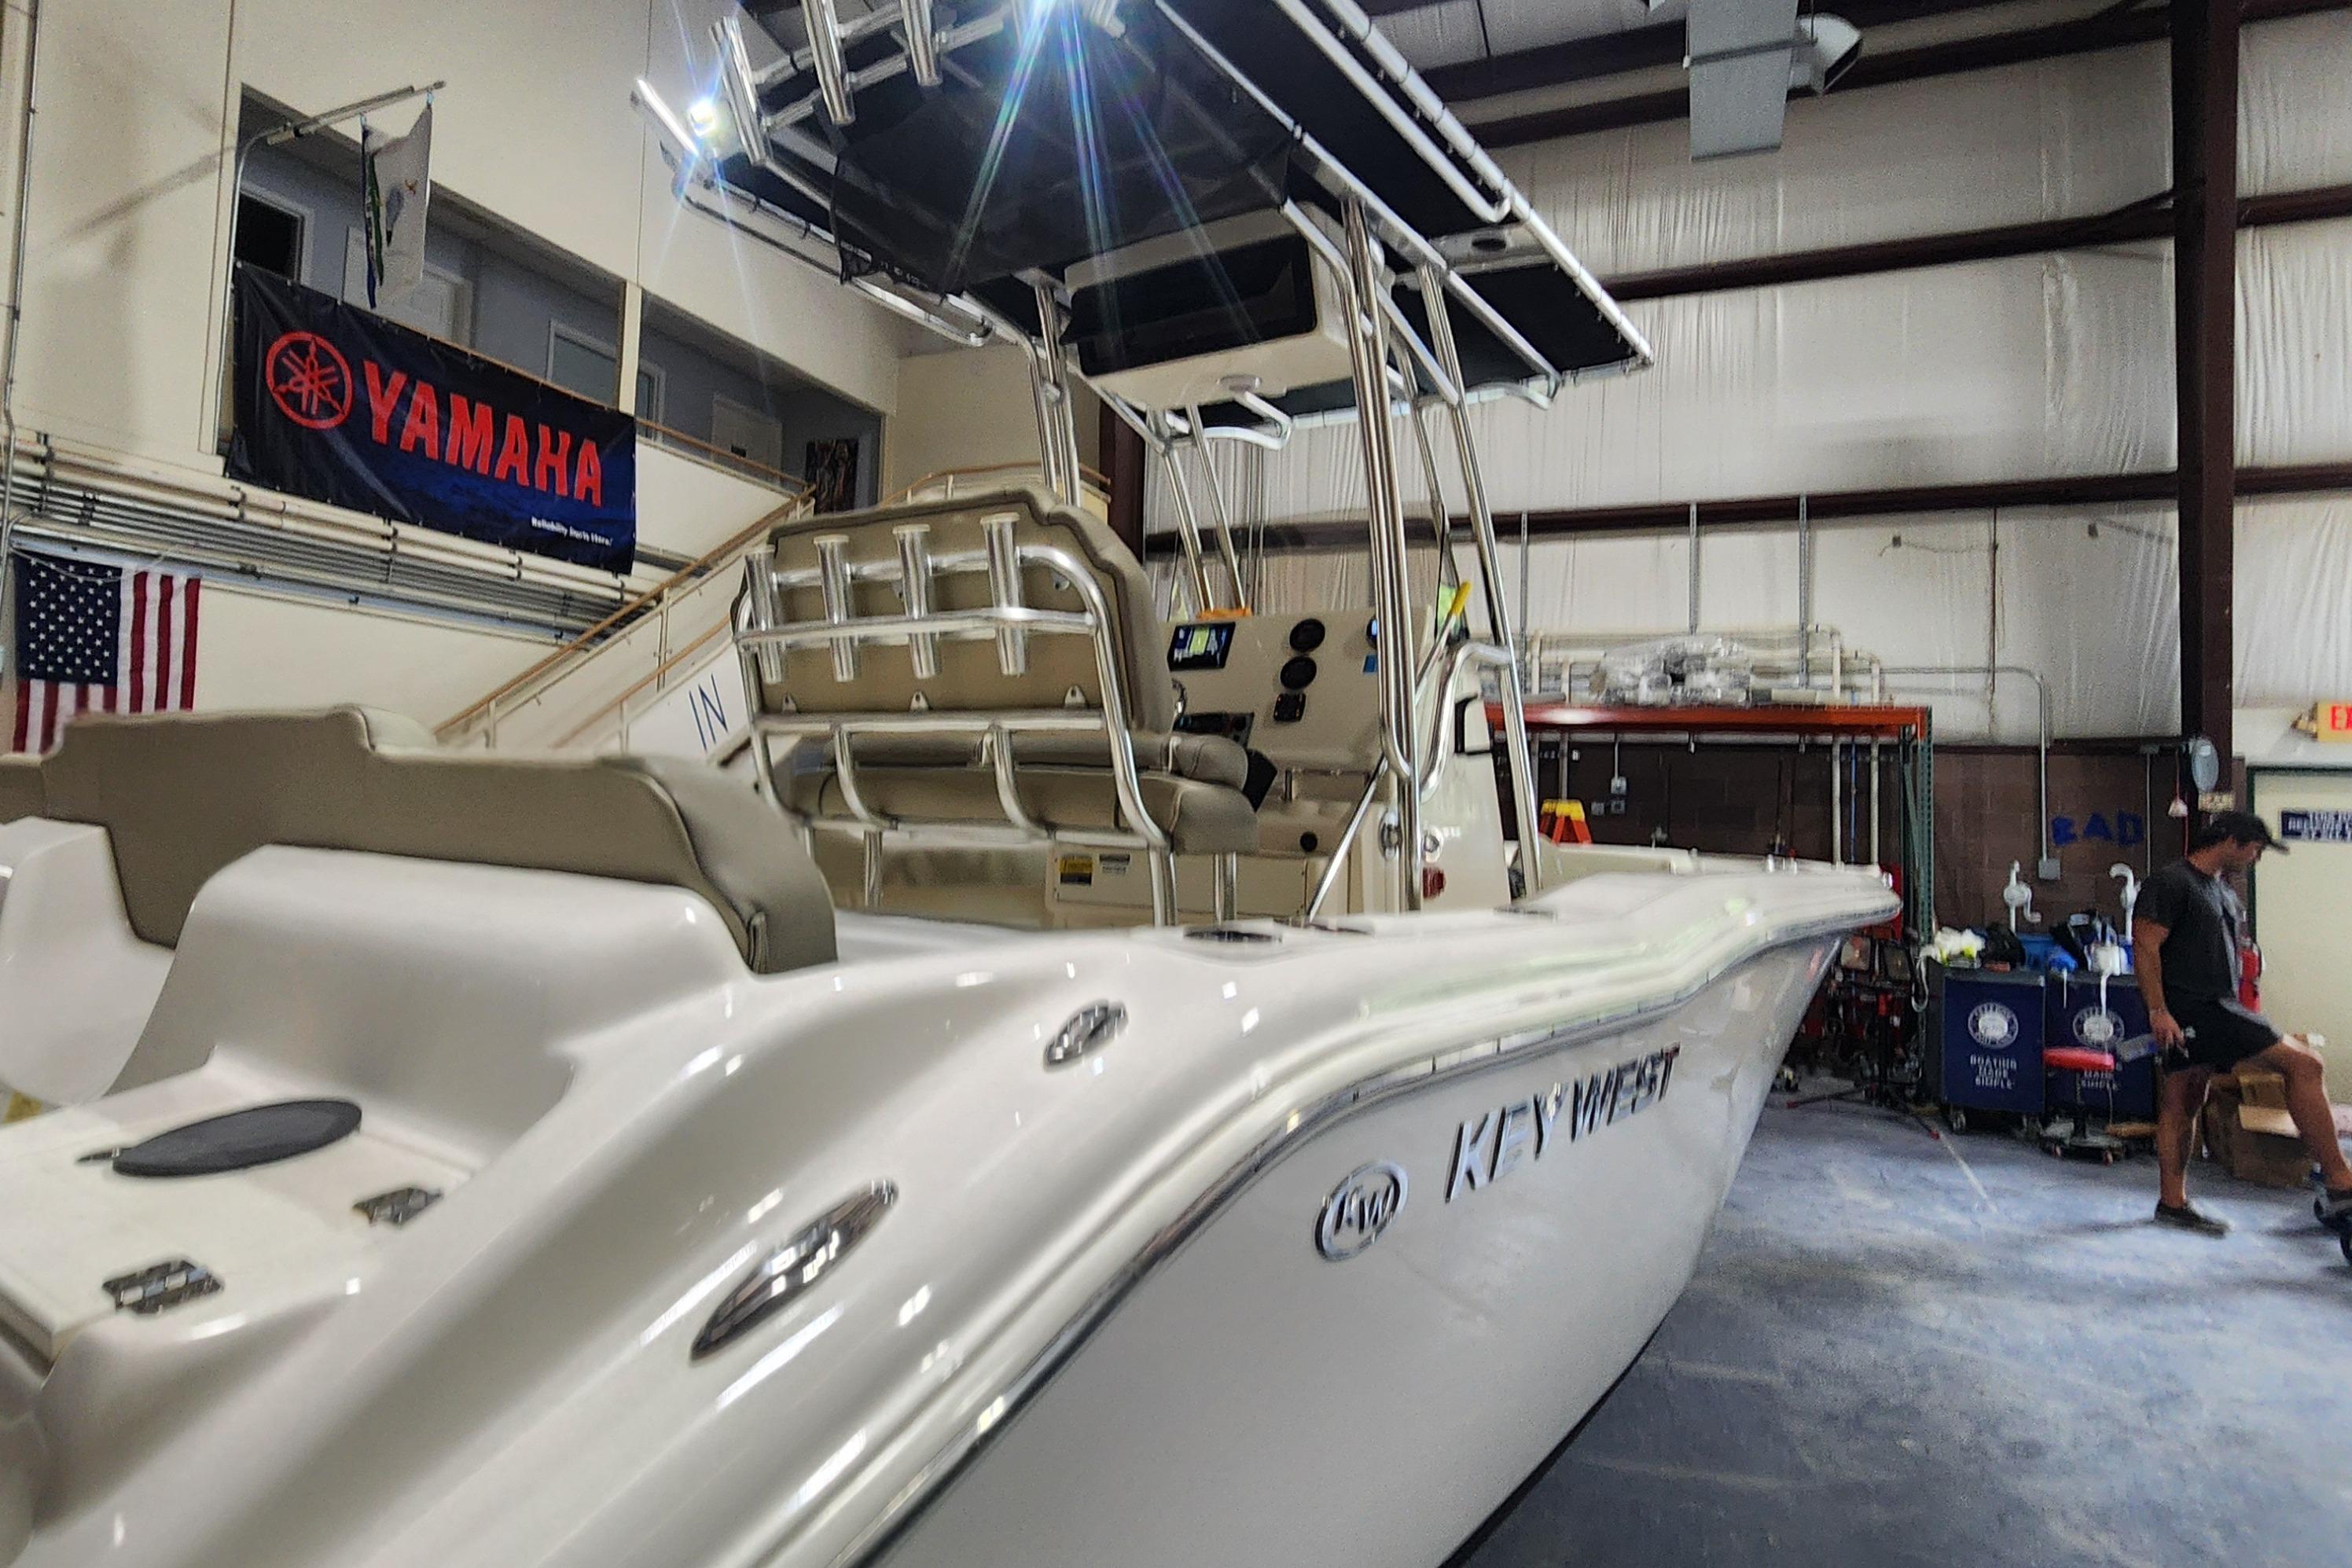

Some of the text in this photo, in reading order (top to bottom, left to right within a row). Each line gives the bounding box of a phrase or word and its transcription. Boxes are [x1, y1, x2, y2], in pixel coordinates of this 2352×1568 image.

[362, 359, 603, 509] YAMAHA
[1445, 1041, 1681, 1204] KEY WEST
